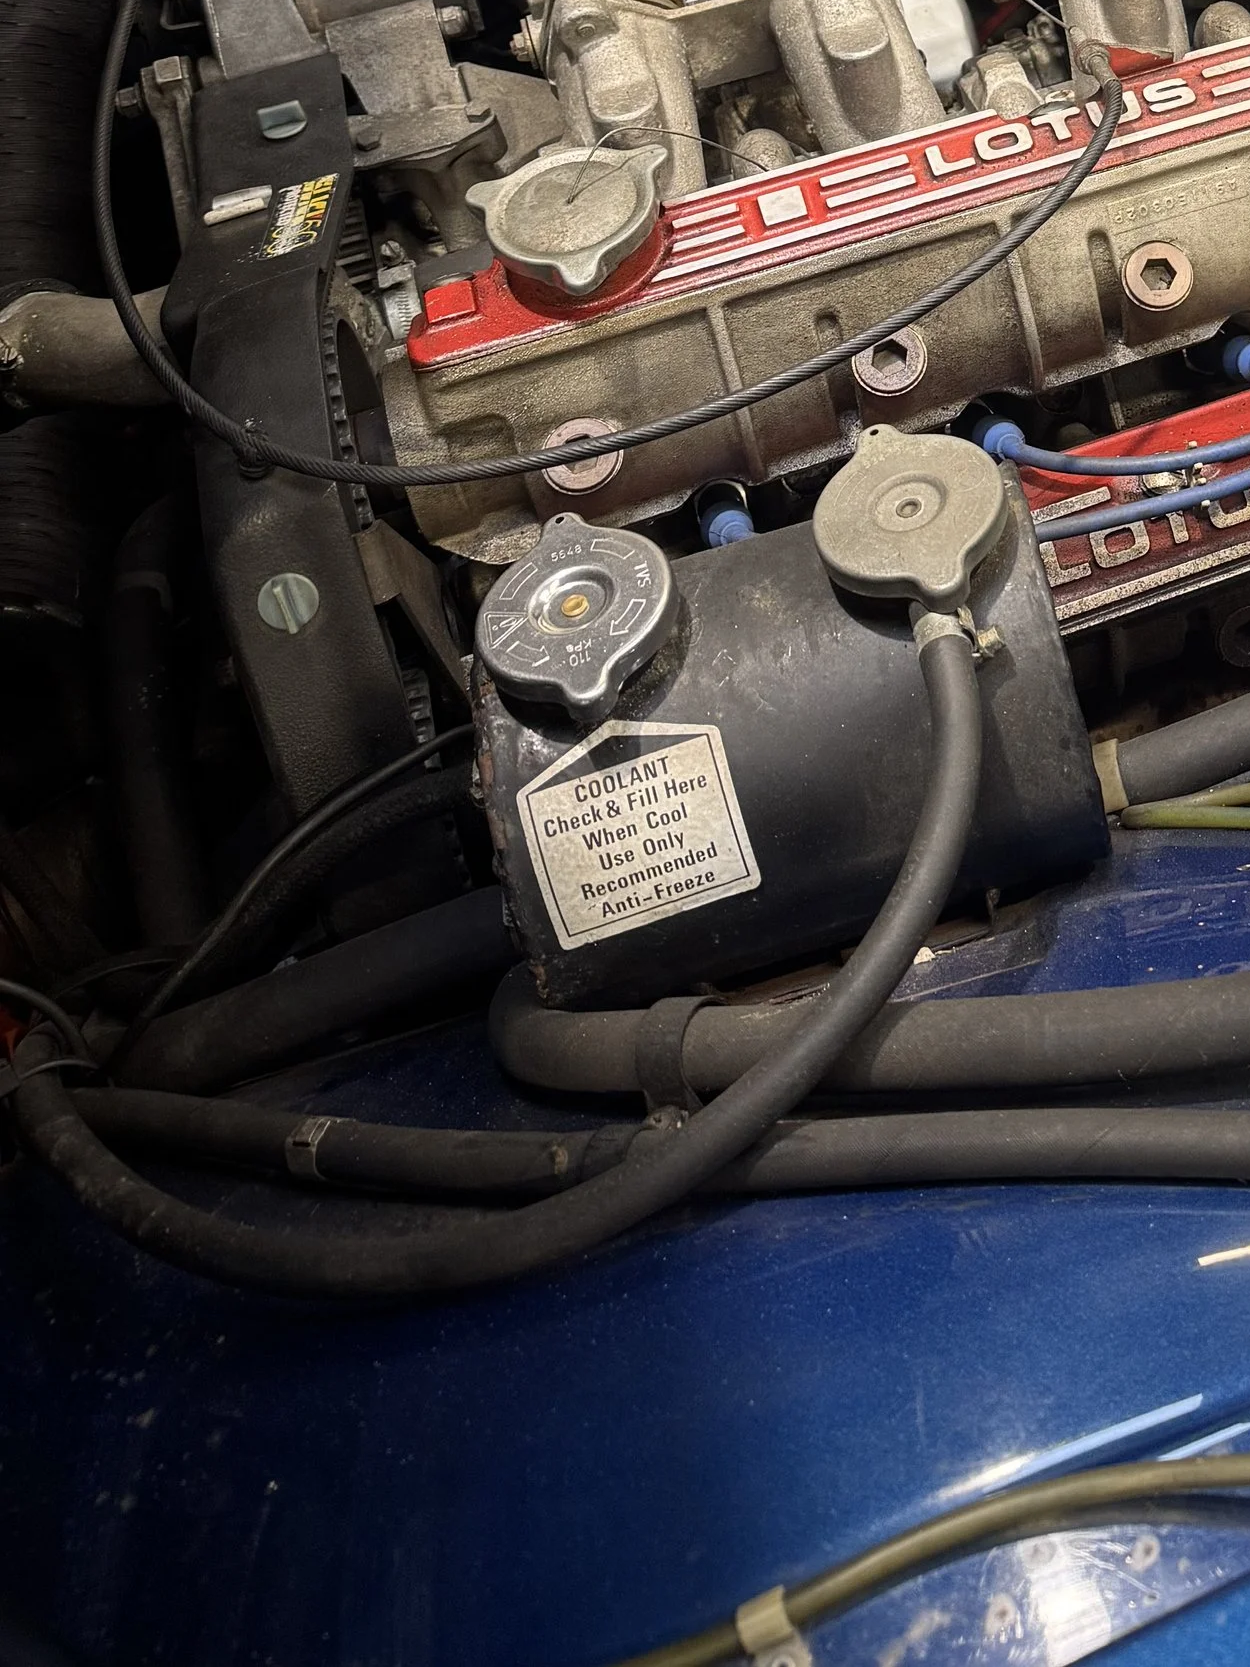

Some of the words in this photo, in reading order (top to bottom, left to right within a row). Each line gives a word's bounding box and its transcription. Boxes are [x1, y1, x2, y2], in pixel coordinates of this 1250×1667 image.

[924, 77, 1198, 178] LOTUS
[551, 544, 583, 563] 5648
[634, 560, 652, 588] TVS
[569, 650, 592, 667] 110
[574, 755, 670, 803] COOLANT
[543, 804, 603, 838] Check
[606, 799, 622, 819] &
[626, 785, 659, 811] Fill
[663, 774, 708, 799] Here
[582, 823, 638, 851] When
[645, 801, 689, 830] Cool
[580, 841, 719, 901] Recommended
[598, 848, 636, 871] Use
[642, 831, 685, 857] Only
[602, 870, 716, 918] Anti-Freeze
